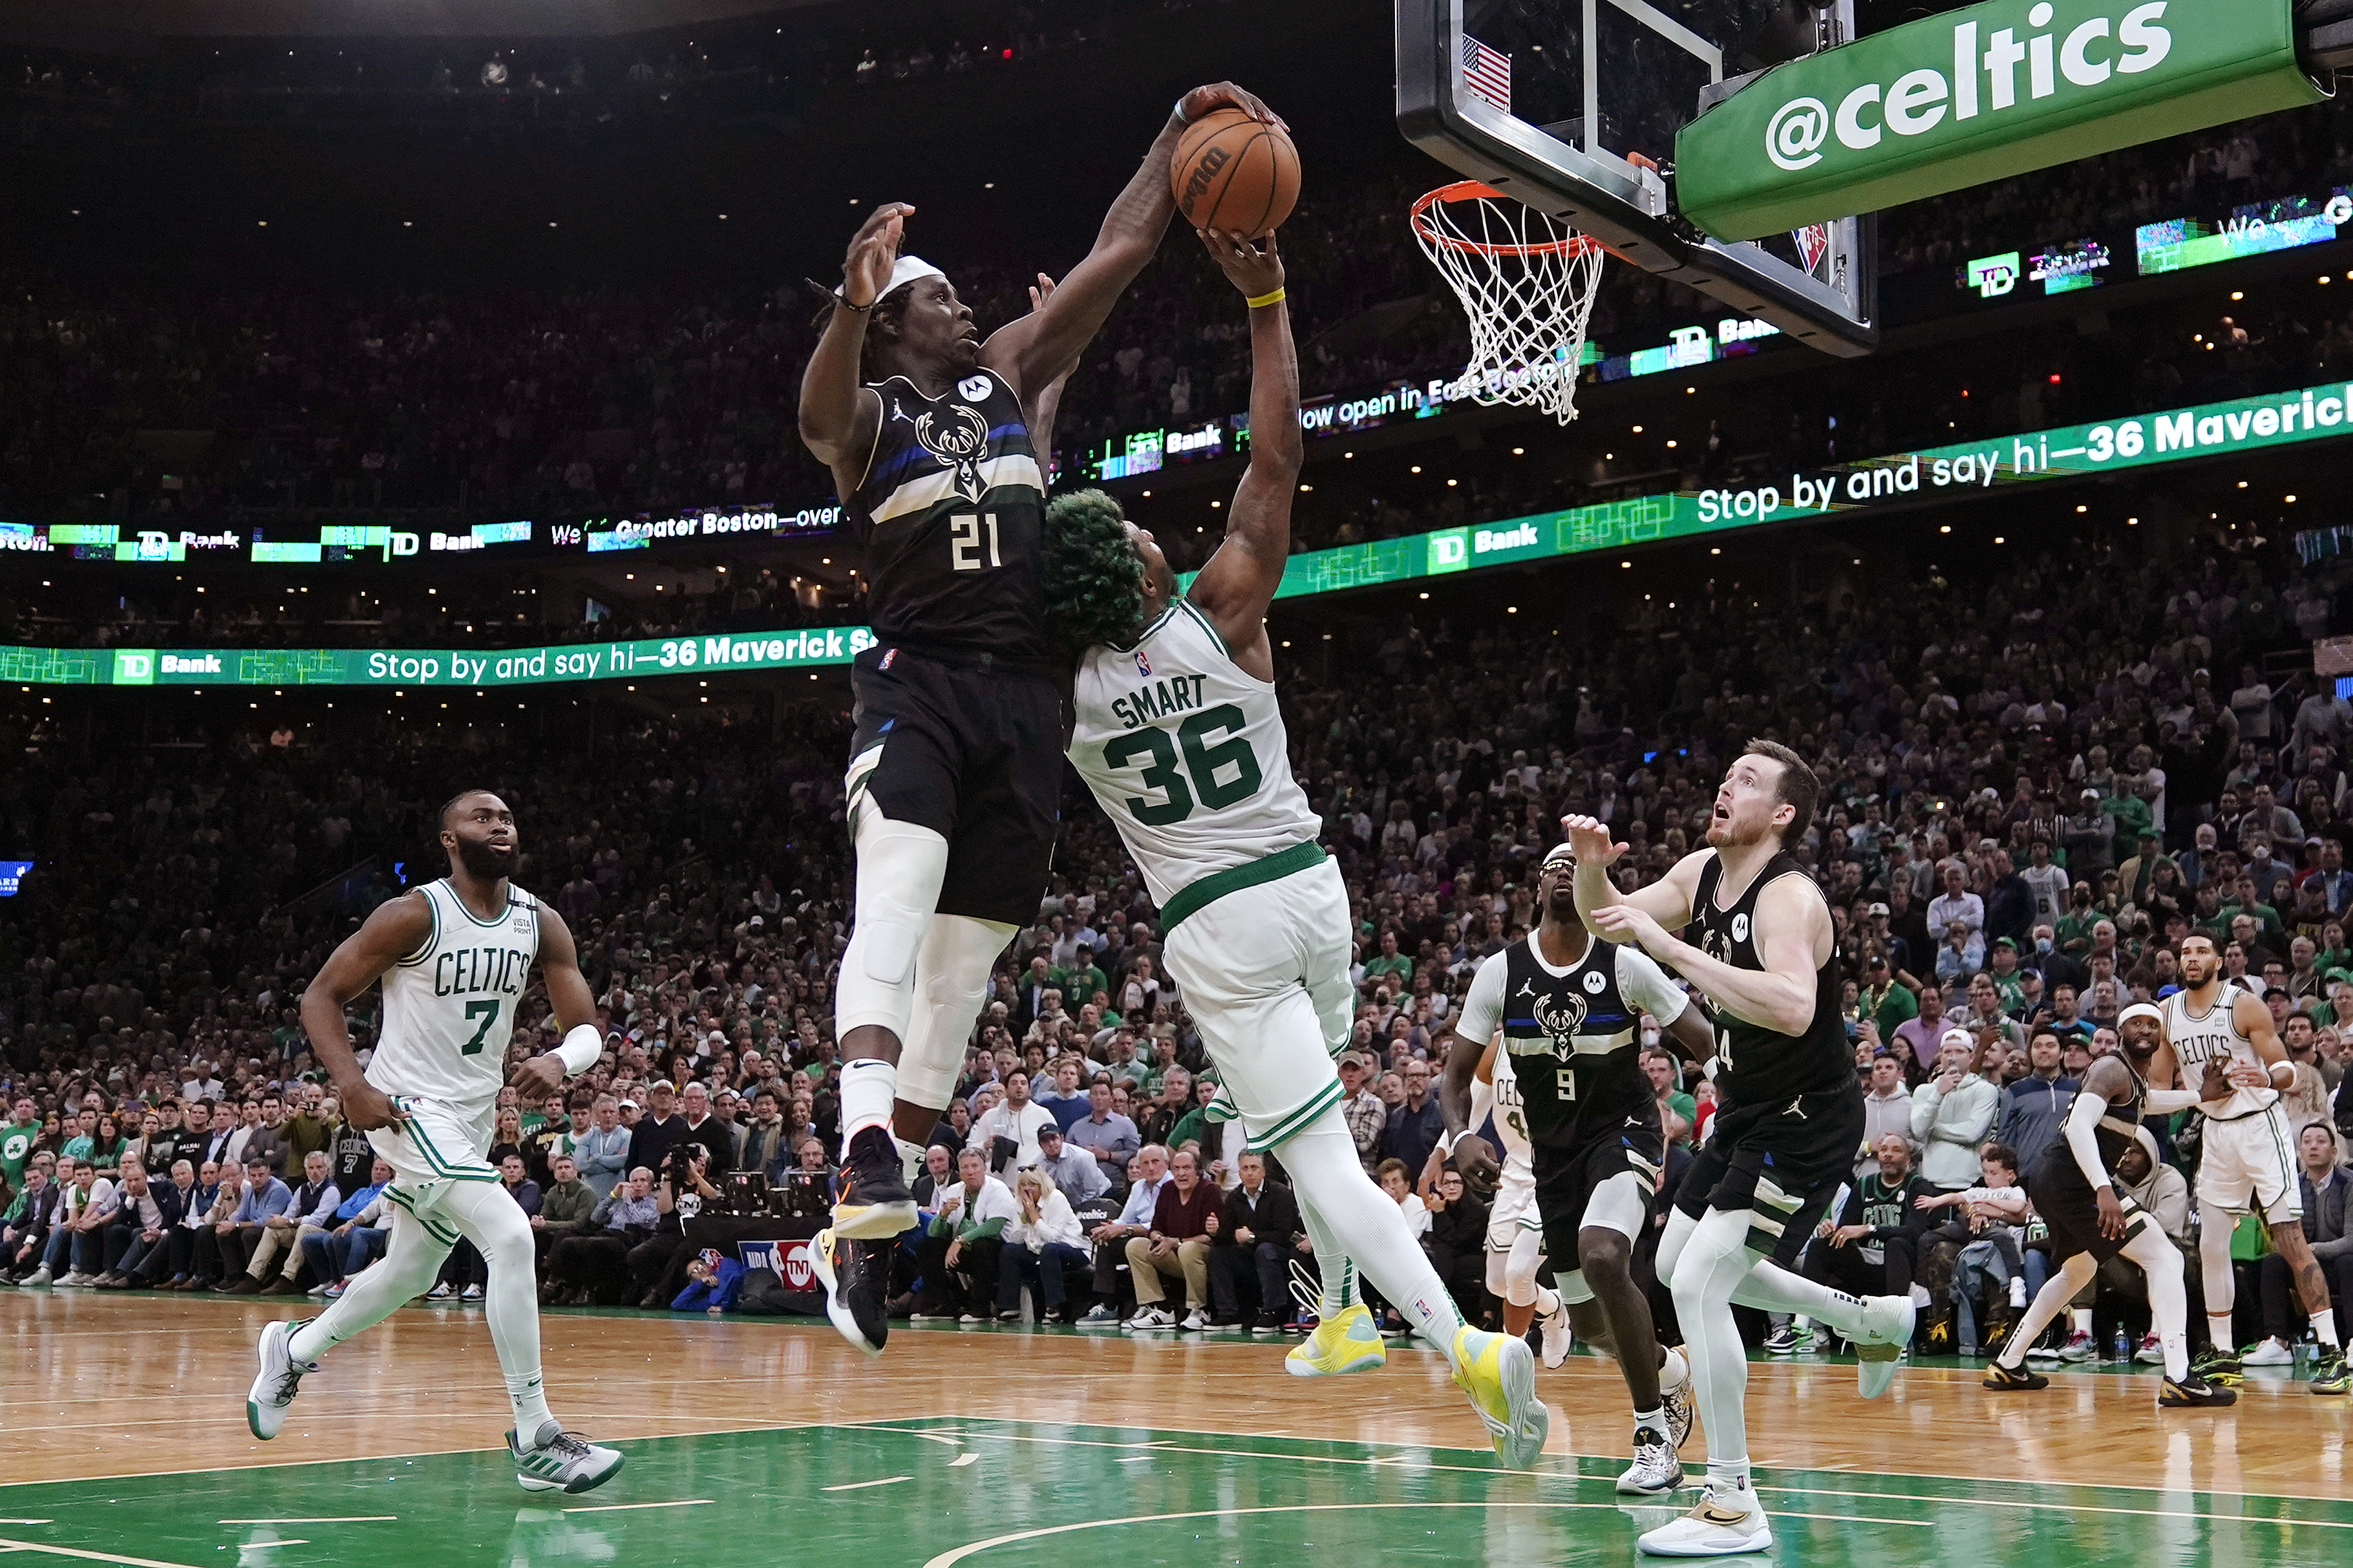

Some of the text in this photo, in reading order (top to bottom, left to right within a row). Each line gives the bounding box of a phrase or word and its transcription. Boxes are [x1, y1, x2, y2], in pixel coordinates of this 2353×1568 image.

[1765, 1, 2172, 171] @celtics
[1338, 394, 1396, 426] open
[1400, 386, 1421, 410] in
[1166, 423, 1222, 454] Bank
[1696, 485, 1780, 525] Stop
[1793, 474, 1836, 514] by
[1847, 456, 1919, 502] and
[1932, 444, 2001, 489] say
[390, 529, 485, 555] TD Bank
[551, 524, 580, 545] We
[615, 518, 698, 541] Greater
[950, 513, 1001, 571] 21
[1431, 522, 1538, 565] TD Bank
[118, 653, 222, 678] TD Bank
[368, 652, 440, 684] Stop
[451, 651, 485, 683] by
[495, 648, 546, 679] and
[554, 648, 601, 679] say
[704, 628, 844, 665] Maverick
[1111, 673, 1207, 730] SMART
[1102, 703, 1263, 826] 36
[512, 918, 531, 928] VISTA
[513, 927, 531, 935] PRINT
[434, 947, 531, 997] CELTICS
[462, 999, 500, 1056] 7
[2173, 1033, 2233, 1066] CELTICS
[1556, 1068, 1577, 1101] 9
[343, 1155, 359, 1174] 7
[786, 1260, 810, 1275] TNT
